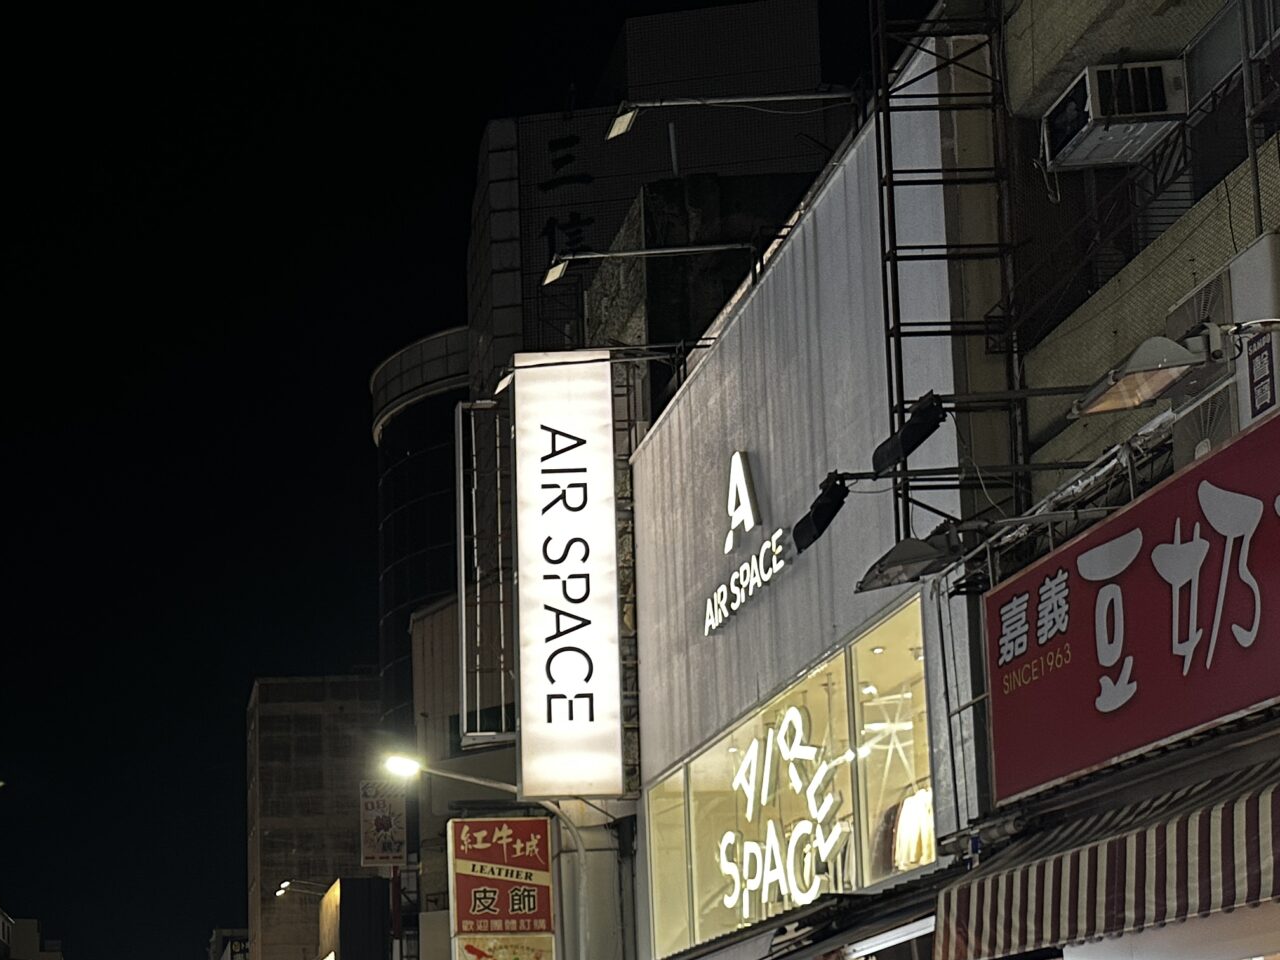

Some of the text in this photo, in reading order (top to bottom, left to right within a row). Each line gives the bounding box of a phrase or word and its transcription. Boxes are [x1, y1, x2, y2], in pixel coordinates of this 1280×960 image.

[540, 424, 595, 724] AIR SPACE
[704, 528, 785, 636] AIR SPACE
[998, 569, 1070, 667] 嘉義
[1077, 480, 1280, 712] 豆奶
[732, 706, 818, 823] AIR
[470, 886, 539, 916] 皮飾
[471, 863, 535, 881] LEATHER
